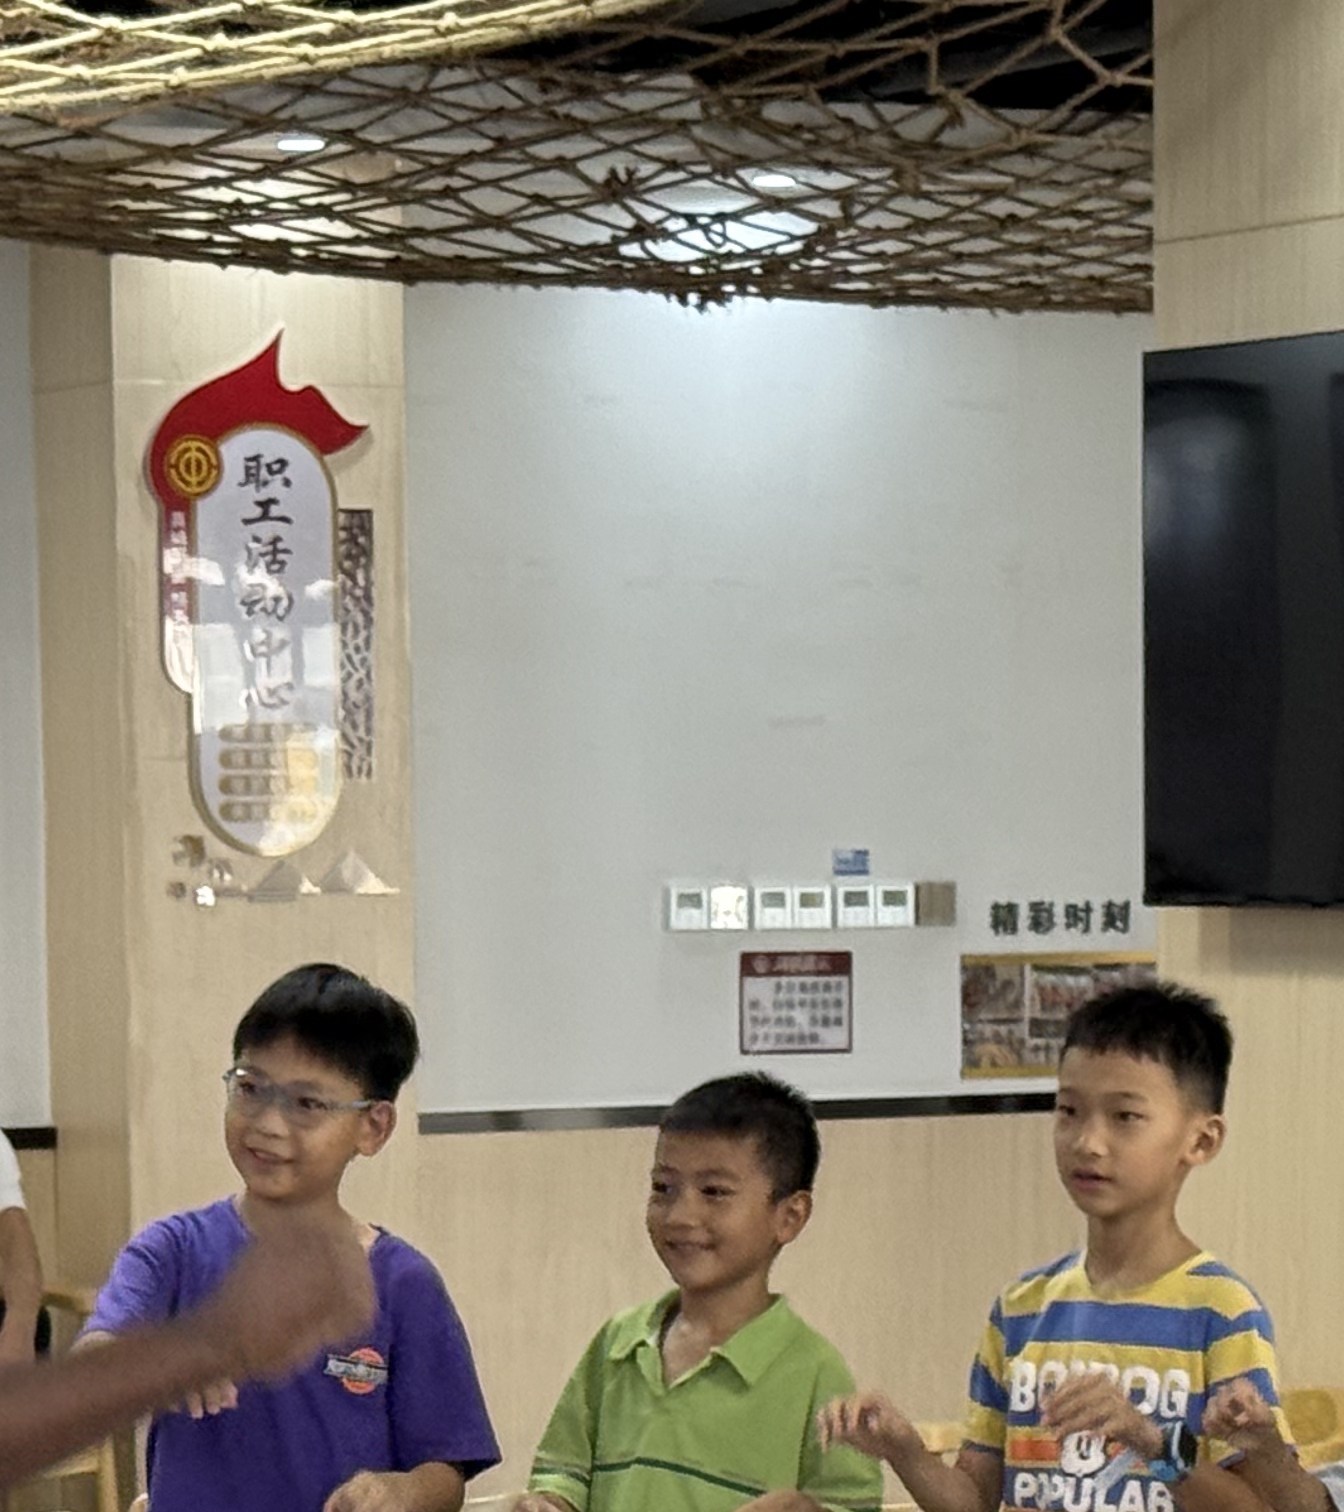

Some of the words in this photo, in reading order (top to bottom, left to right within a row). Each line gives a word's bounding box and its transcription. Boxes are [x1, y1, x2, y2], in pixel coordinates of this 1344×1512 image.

[236, 452, 296, 711] 职工活动中心
[989, 899, 1131, 937] 精彩时刻
[1009, 1359, 1191, 1421] BOOG
